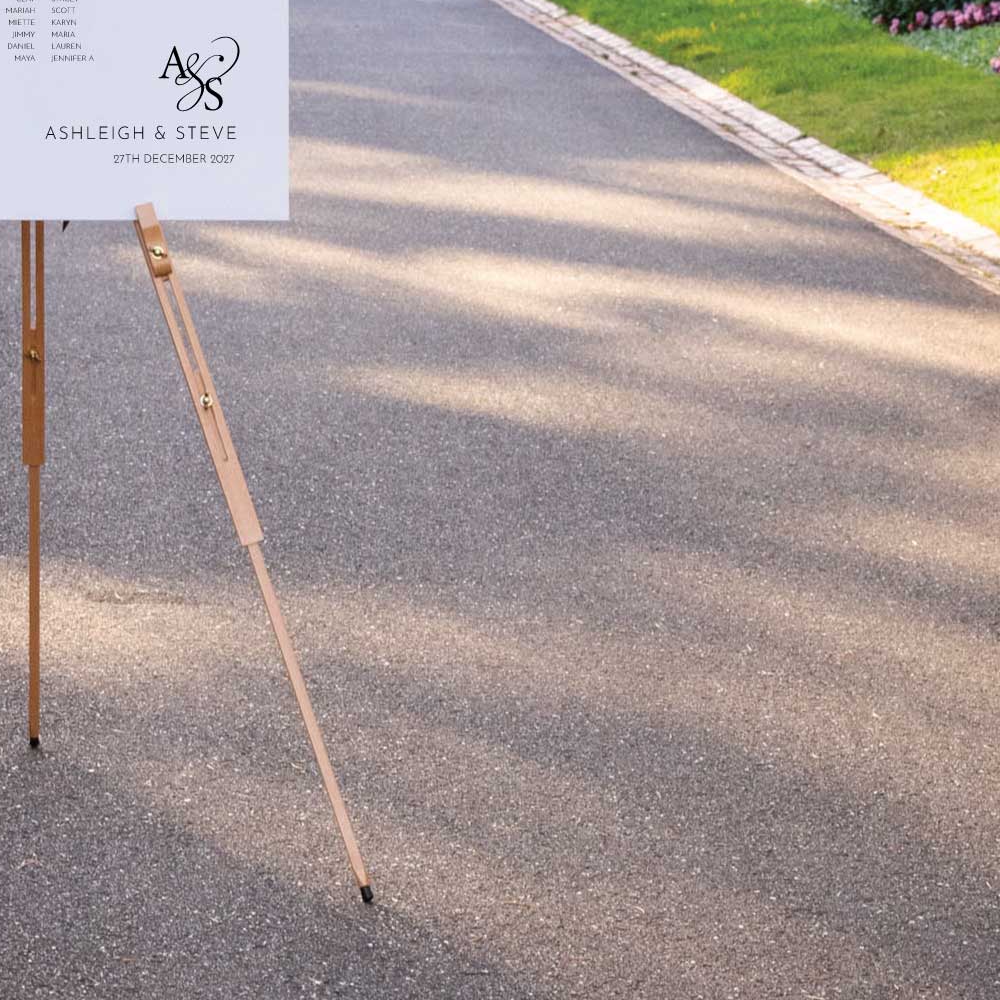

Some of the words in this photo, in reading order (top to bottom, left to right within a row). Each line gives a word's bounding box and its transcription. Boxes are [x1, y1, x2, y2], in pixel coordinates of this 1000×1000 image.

[5, 6, 36, 15] MARIAH
[51, 6, 76, 14] SCOTT
[50, 17, 77, 27] KARYN
[11, 30, 36, 40] JIMMY
[51, 30, 76, 38] MARIA
[7, 41, 36, 50] DANIEL
[51, 41, 82, 50] LAUREN
[14, 54, 37, 62] MAYA
[50, 54, 87, 63] JENNIFER
[44, 124, 145, 142] ASHLEIGH
[153, 124, 168, 141] &
[175, 125, 238, 141] STEVE
[113, 152, 141, 165] 27TH
[143, 153, 207, 165] DECEMBER
[209, 153, 236, 165] 2027
